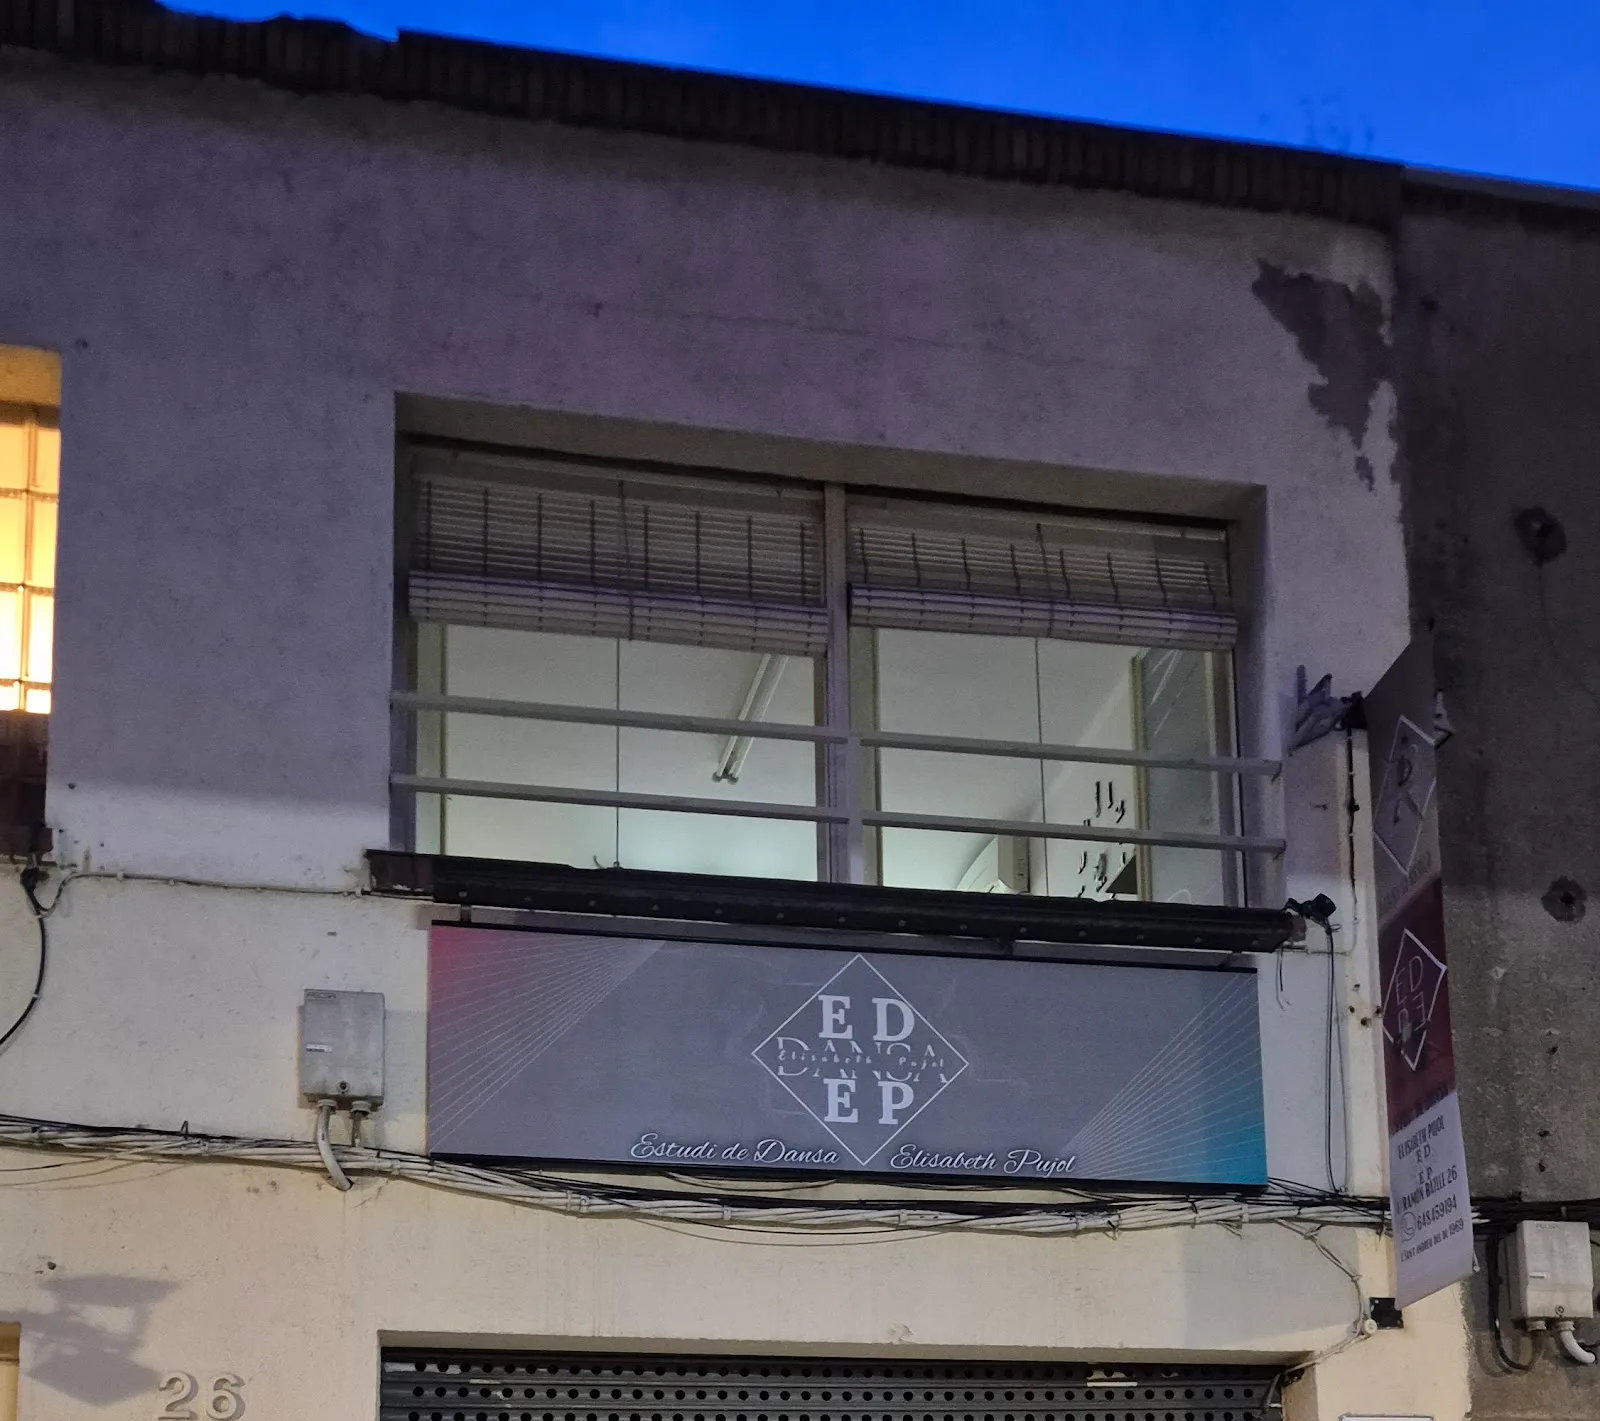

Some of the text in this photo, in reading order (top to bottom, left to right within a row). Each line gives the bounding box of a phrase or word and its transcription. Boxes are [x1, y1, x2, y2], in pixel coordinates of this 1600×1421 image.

[630, 1132, 841, 1164] Estudi de Dansa
[890, 1143, 1077, 1178] Elisabeth Pujol
[1447, 1164, 1458, 1184] 26
[158, 1370, 246, 1421] 26
